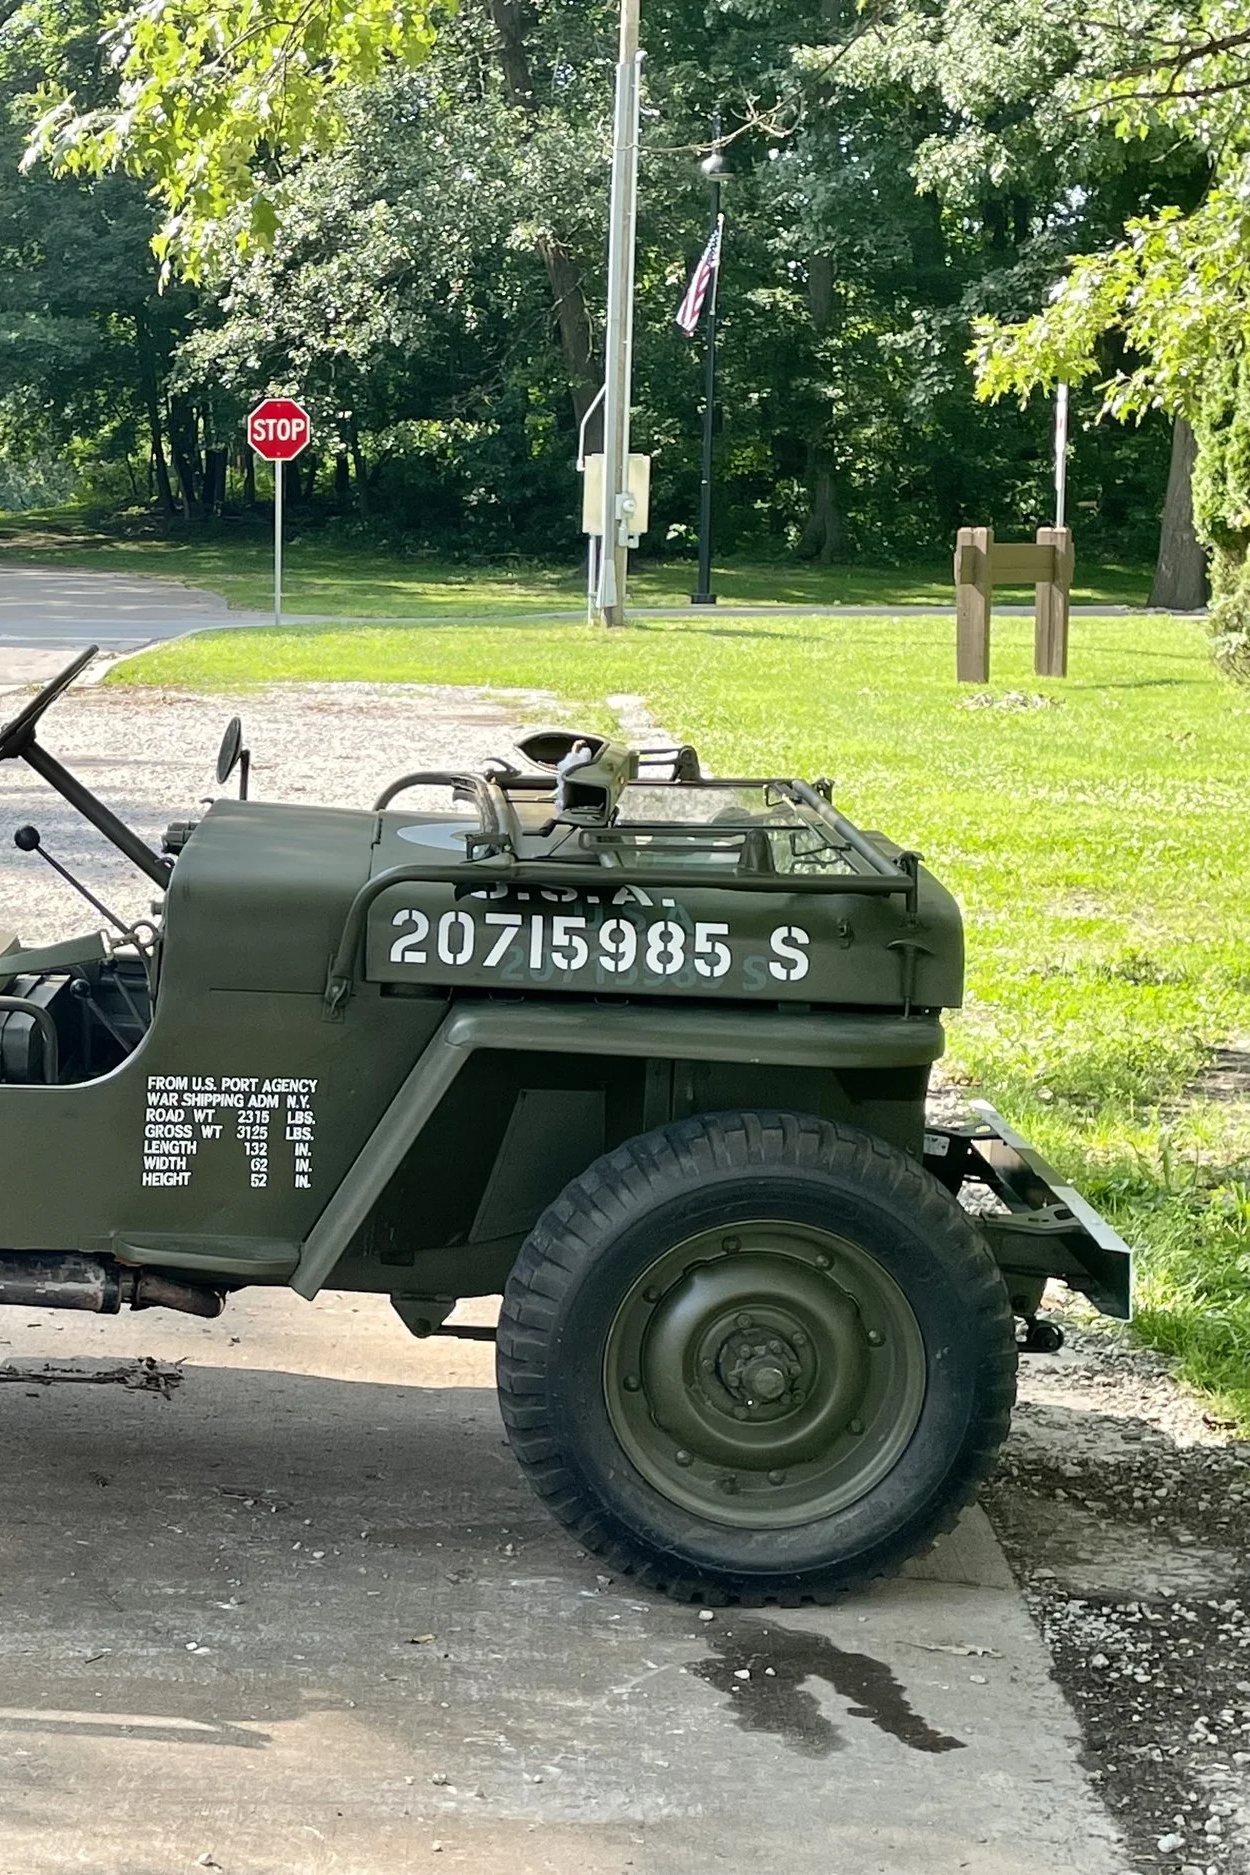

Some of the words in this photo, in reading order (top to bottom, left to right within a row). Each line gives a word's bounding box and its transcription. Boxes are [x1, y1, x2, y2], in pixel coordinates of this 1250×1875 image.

[253, 418, 305, 441] STOP
[390, 908, 731, 978] 20715985
[768, 925, 811, 981] S
[147, 1076, 188, 1091] FROM
[192, 1076, 217, 1092] U.S.
[221, 1077, 259, 1092] PORT
[262, 1078, 318, 1093] AGENCY
[147, 1092, 178, 1107] WAR
[181, 1093, 244, 1108] SHIPPING
[247, 1094, 279, 1108] ADM
[286, 1095, 310, 1109] N.Y.
[145, 1108, 185, 1122] ROAD
[193, 1109, 216, 1123] WT
[237, 1110, 270, 1124] 2315
[287, 1111, 316, 1125] LBS.
[144, 1124, 193, 1139] GROSS
[201, 1125, 224, 1139] WT
[236, 1125, 268, 1140] 3125
[285, 1127, 315, 1141] LBS.
[143, 1140, 197, 1155] LENGTH
[244, 1142, 268, 1156] 132
[294, 1142, 312, 1156] IN.
[143, 1156, 187, 1170] WIDTH
[250, 1158, 268, 1172] 62
[295, 1158, 312, 1172] IN.
[142, 1172, 191, 1187] HEIGHT
[250, 1173, 267, 1188] 52
[295, 1174, 312, 1188] IN.
